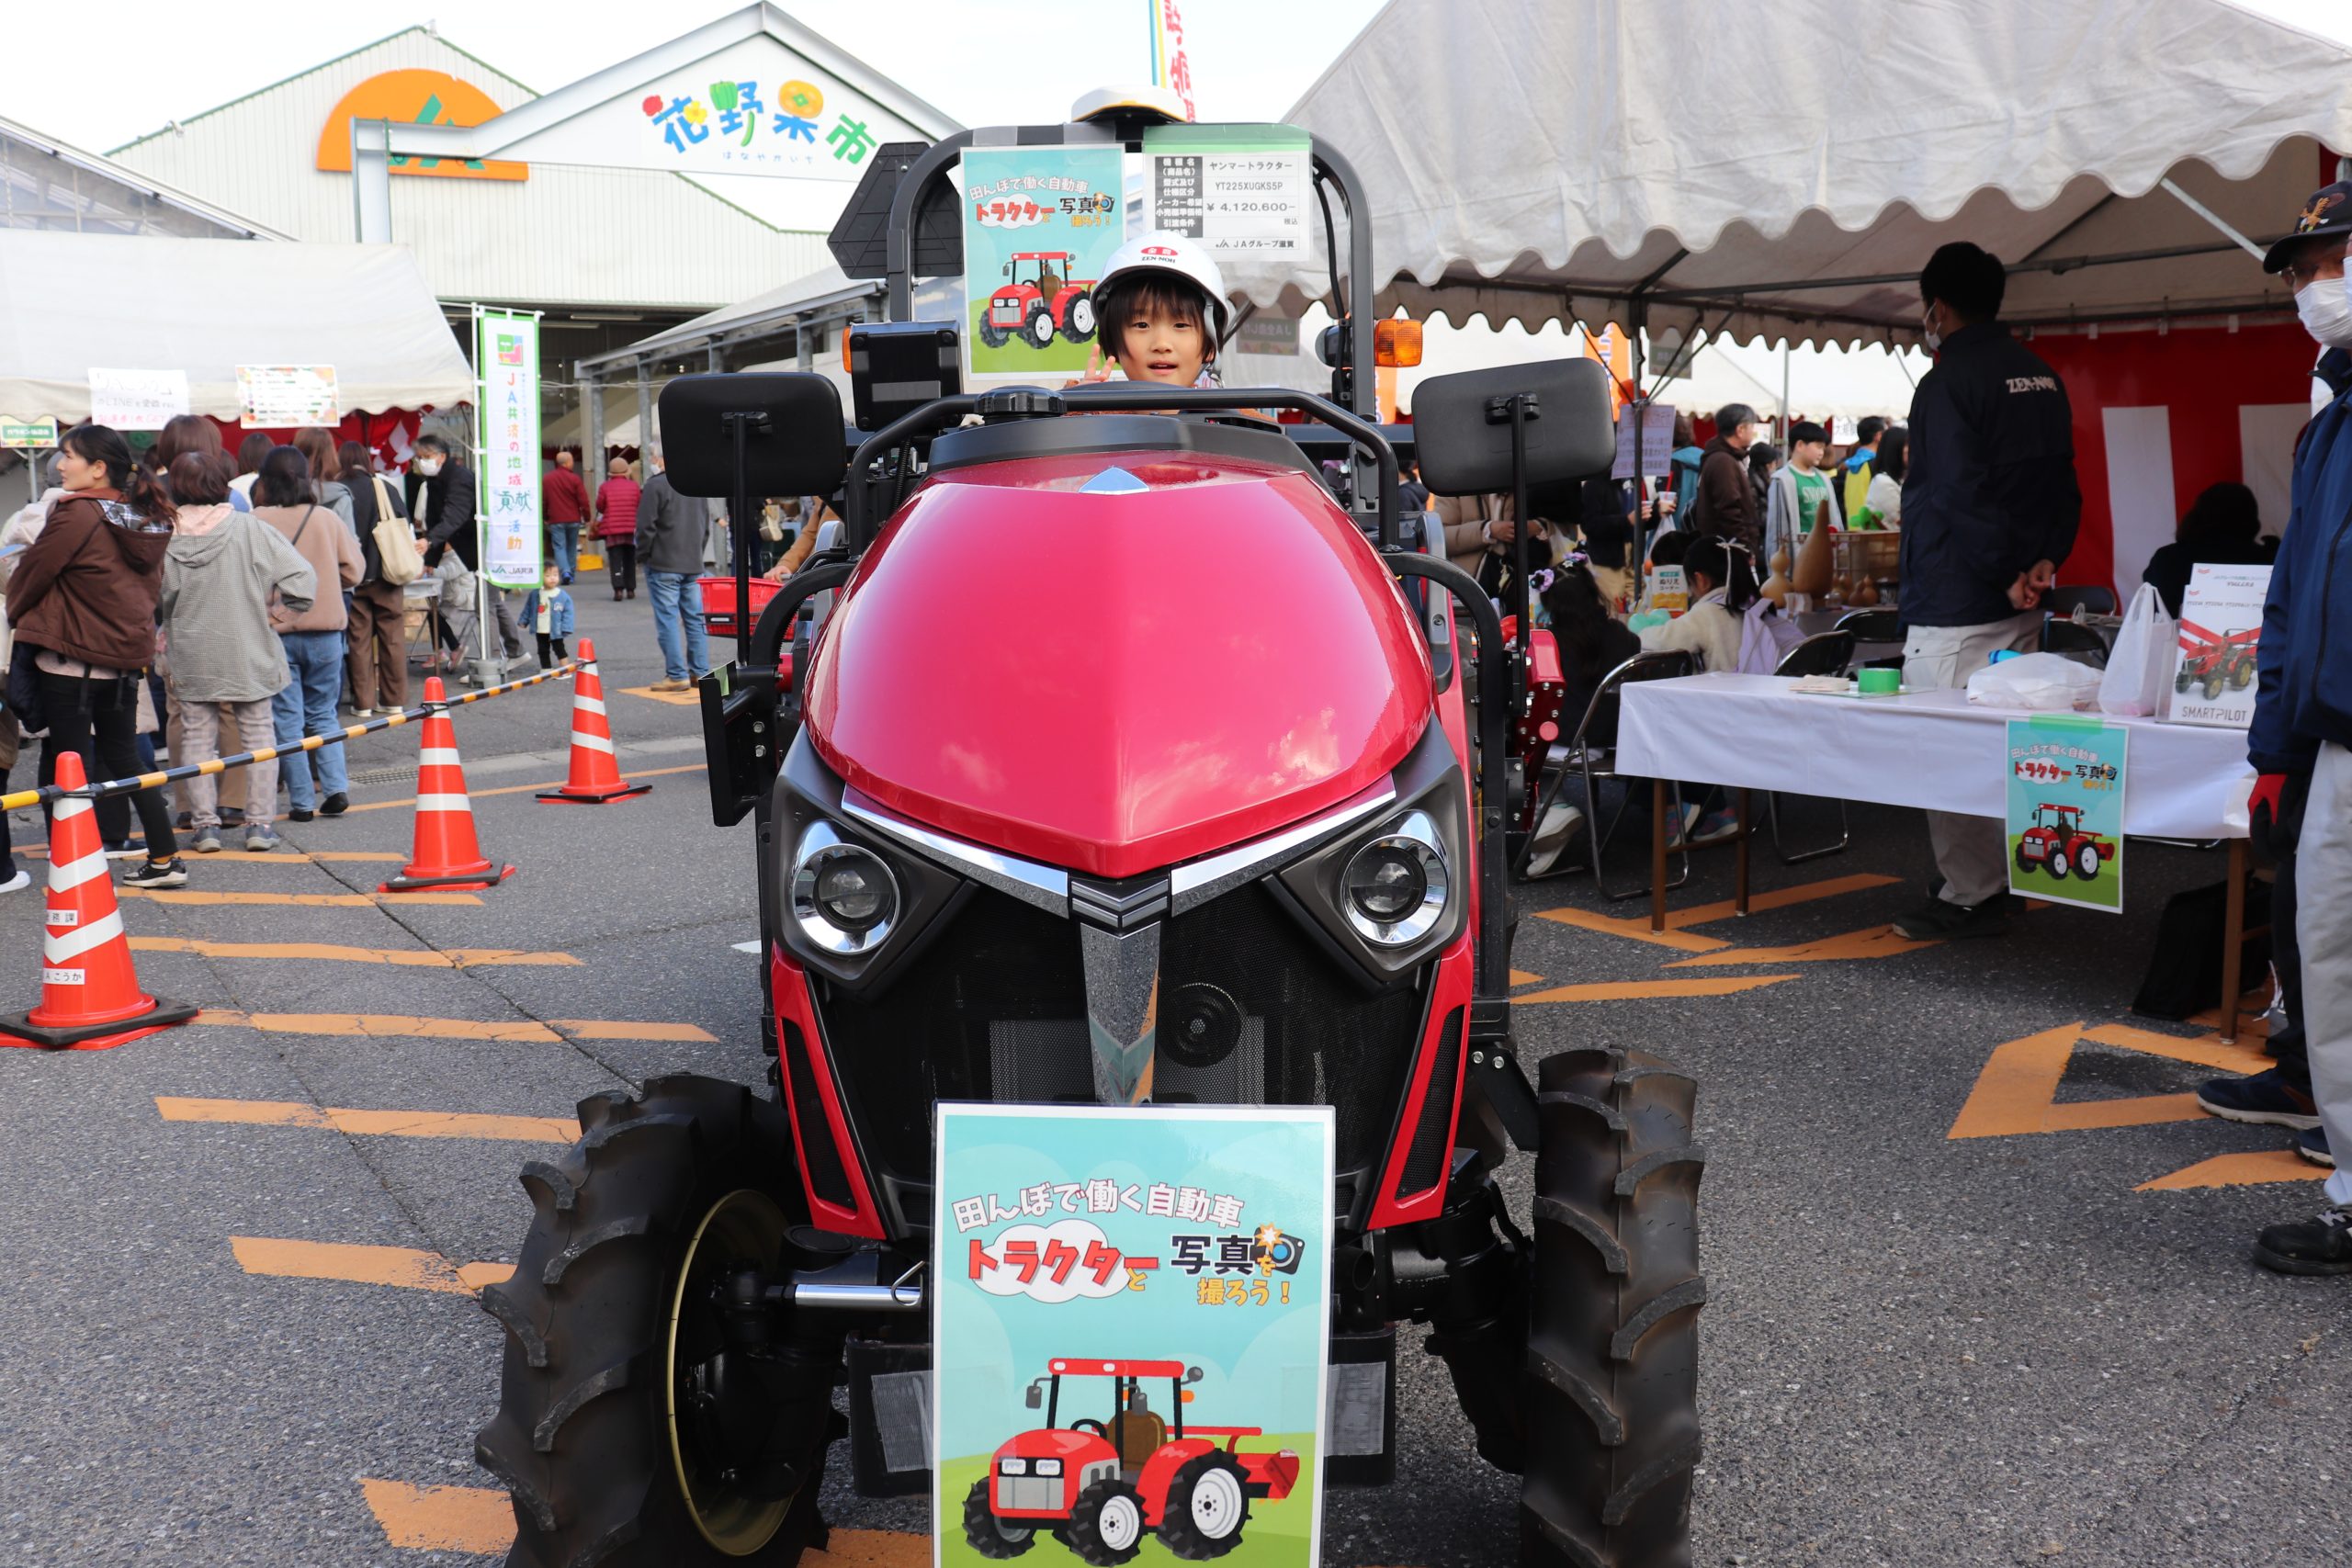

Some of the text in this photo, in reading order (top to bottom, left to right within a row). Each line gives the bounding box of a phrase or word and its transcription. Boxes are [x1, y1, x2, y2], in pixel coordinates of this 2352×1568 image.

[642, 80, 878, 164] 花野果市
[1209, 162, 1293, 170] ヤンマートラクター
[968, 175, 1090, 201] 田んぼで働く自動車
[1216, 182, 1283, 191] YT225XUGKS5P
[2182, 706, 2248, 722] SMARTPILOT
[2011, 743, 2098, 763] 田んぼで働く自動車
[951, 1179, 1245, 1233] 田んぼで働く自動車
[1196, 1278, 1291, 1307] 撮ろう！
